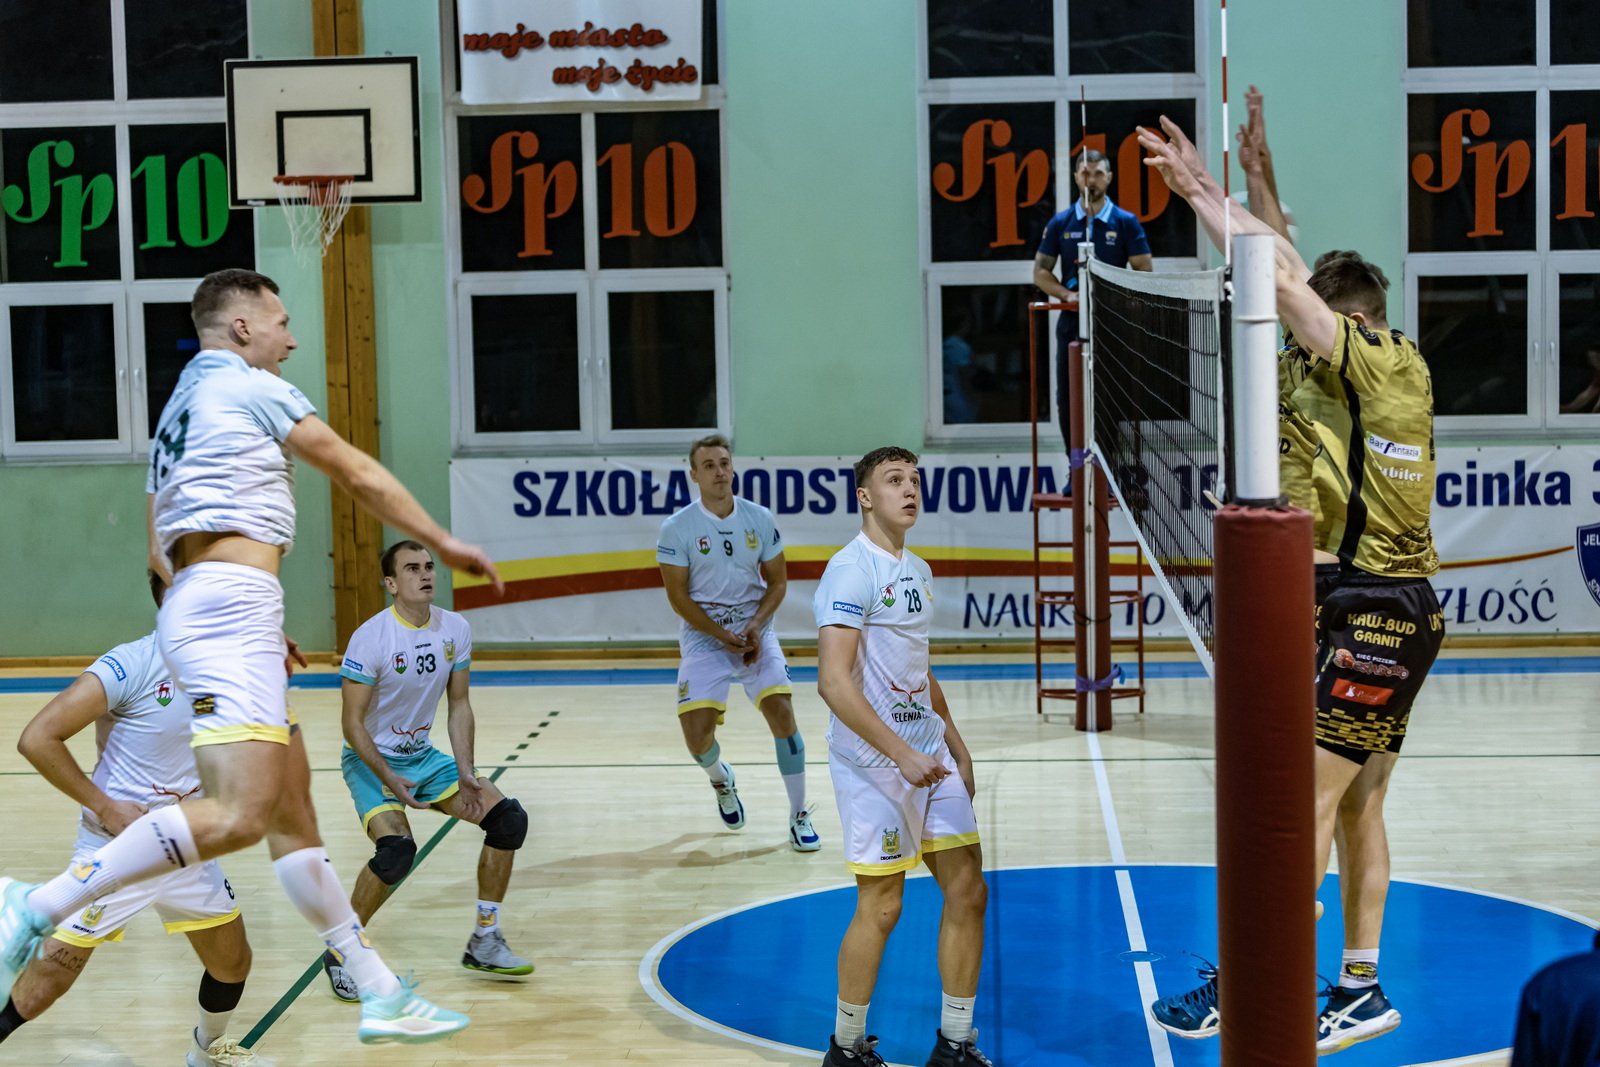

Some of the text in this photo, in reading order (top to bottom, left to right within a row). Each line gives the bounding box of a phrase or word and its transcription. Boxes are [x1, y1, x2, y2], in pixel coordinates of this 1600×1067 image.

[463, 23, 545, 59] moje
[553, 57, 698, 92] moje życie
[1551, 123, 1600, 220] 1
[131, 152, 230, 250] 10
[597, 141, 697, 239] 10
[1369, 435, 1384, 449] Bar
[513, 470, 693, 517] SZKOŁA
[1435, 459, 1572, 507] cinka
[723, 540, 733, 557] 9
[833, 602, 863, 616] DECATHLON
[904, 588, 922, 613] 28
[963, 592, 1076, 629] NAUK
[1438, 578, 1558, 625] ZŁOŚĆ
[1347, 613, 1417, 635] KAW-BUD
[1353, 630, 1404, 649] GRANIT
[416, 653, 437, 676] 33
[224, 878, 236, 900] 8
